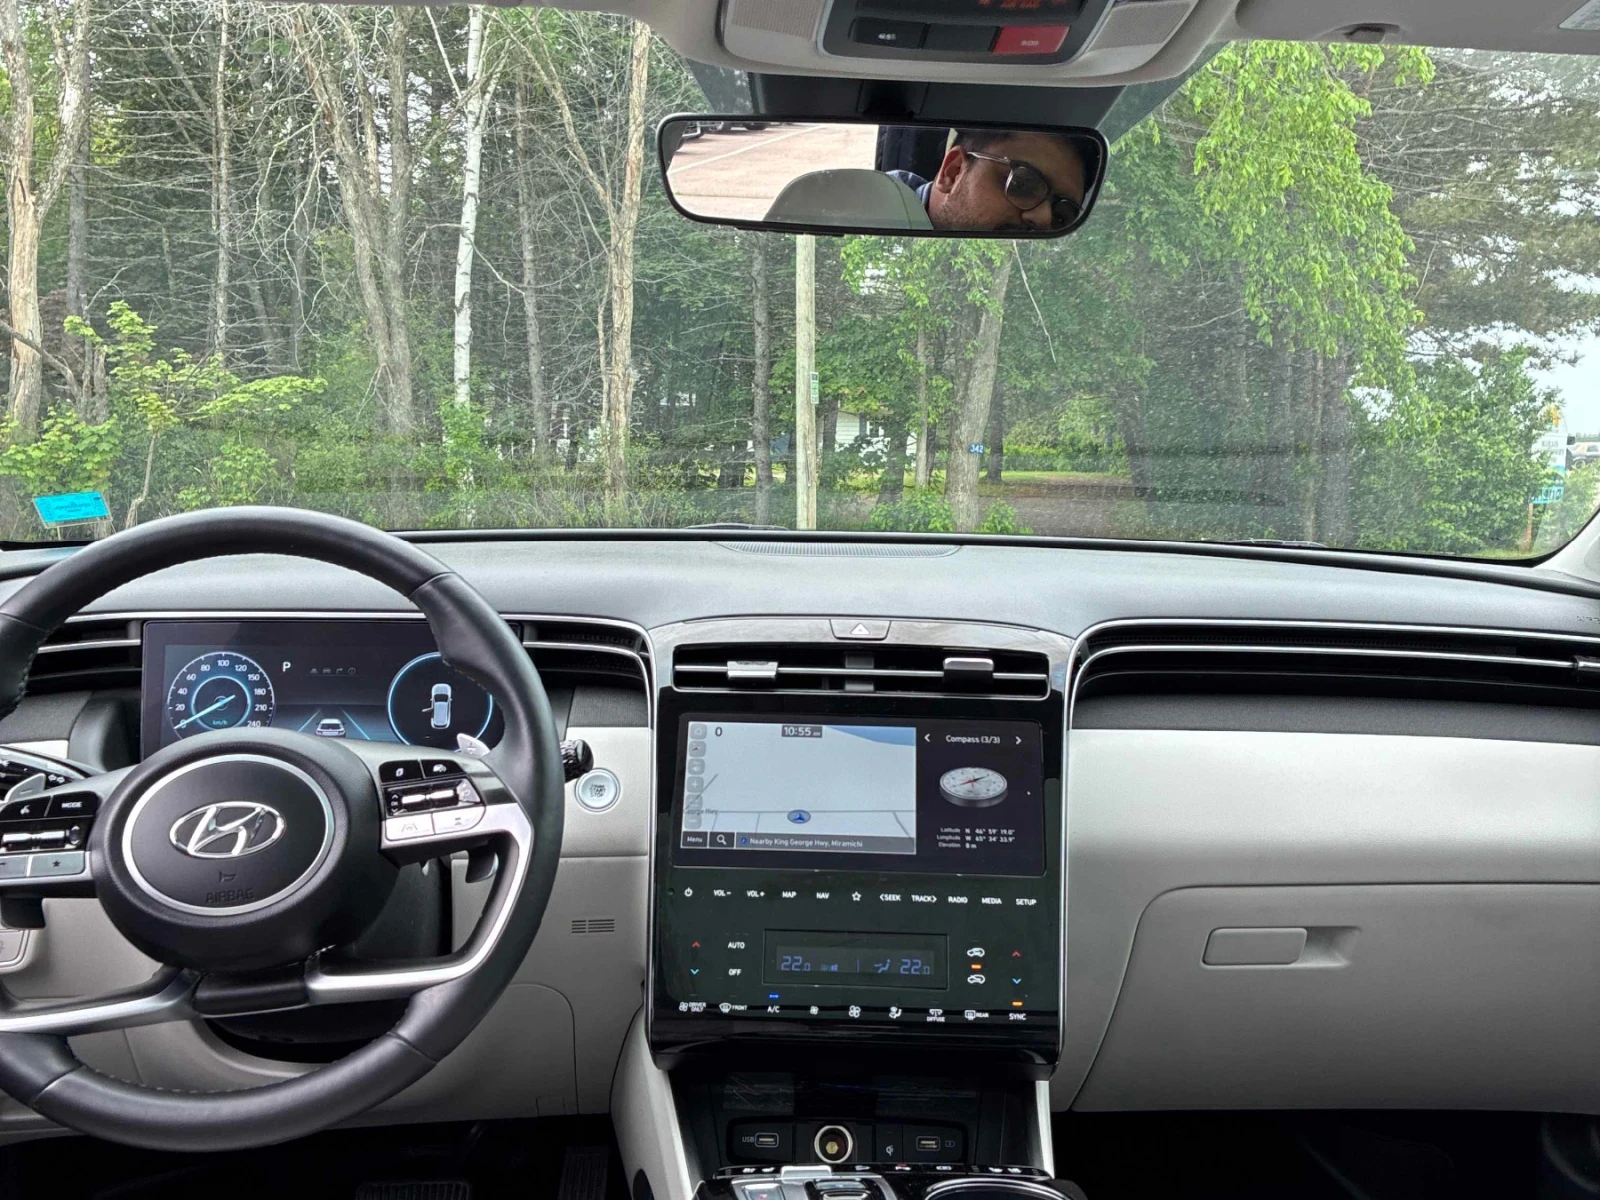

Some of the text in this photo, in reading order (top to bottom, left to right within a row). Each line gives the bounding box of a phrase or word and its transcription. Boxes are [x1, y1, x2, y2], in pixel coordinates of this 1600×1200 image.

[970, 444, 984, 453] 342
[235, 664, 247, 672] 120
[282, 661, 291, 672] P
[177, 687, 188, 695] 40
[784, 726, 811, 736] 10:55
[945, 735, 1001, 744] Compass (3/3)
[750, 838, 773, 846] Nearby
[774, 838, 789, 847] King
[790, 839, 813, 847] George
[205, 888, 255, 904] AIRBAG
[948, 896, 968, 904] RADIO
[982, 897, 1002, 905] MEDIA
[1015, 898, 1037, 906] SETUP
[728, 941, 746, 949] AUTO
[729, 968, 742, 976] OFF
[767, 1005, 780, 1013] A/C
